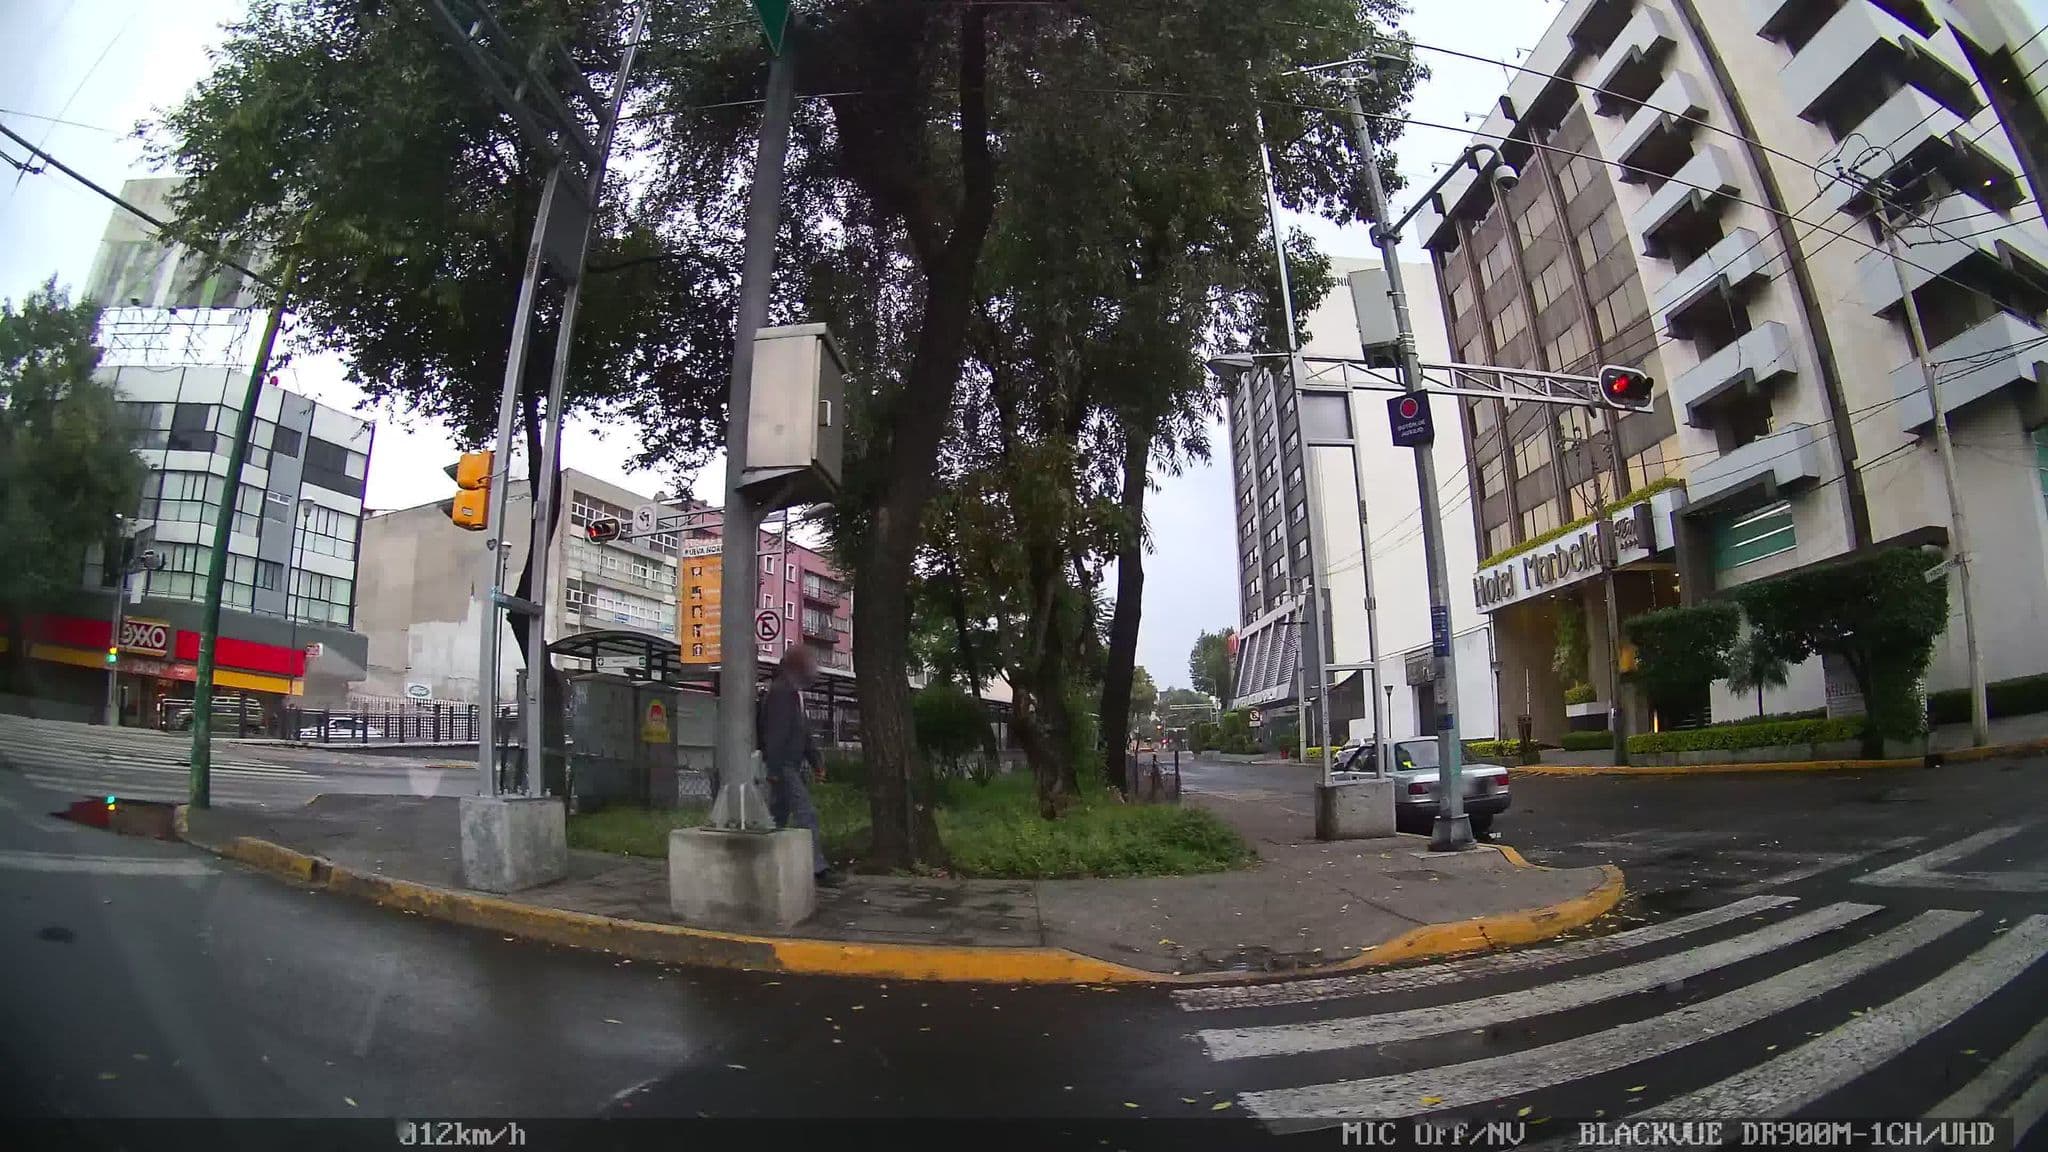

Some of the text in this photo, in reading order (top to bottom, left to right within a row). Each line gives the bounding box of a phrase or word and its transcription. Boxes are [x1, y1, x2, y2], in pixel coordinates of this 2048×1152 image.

[1472, 532, 1604, 608] Hotel Marbella
[120, 623, 166, 648] OXXO
